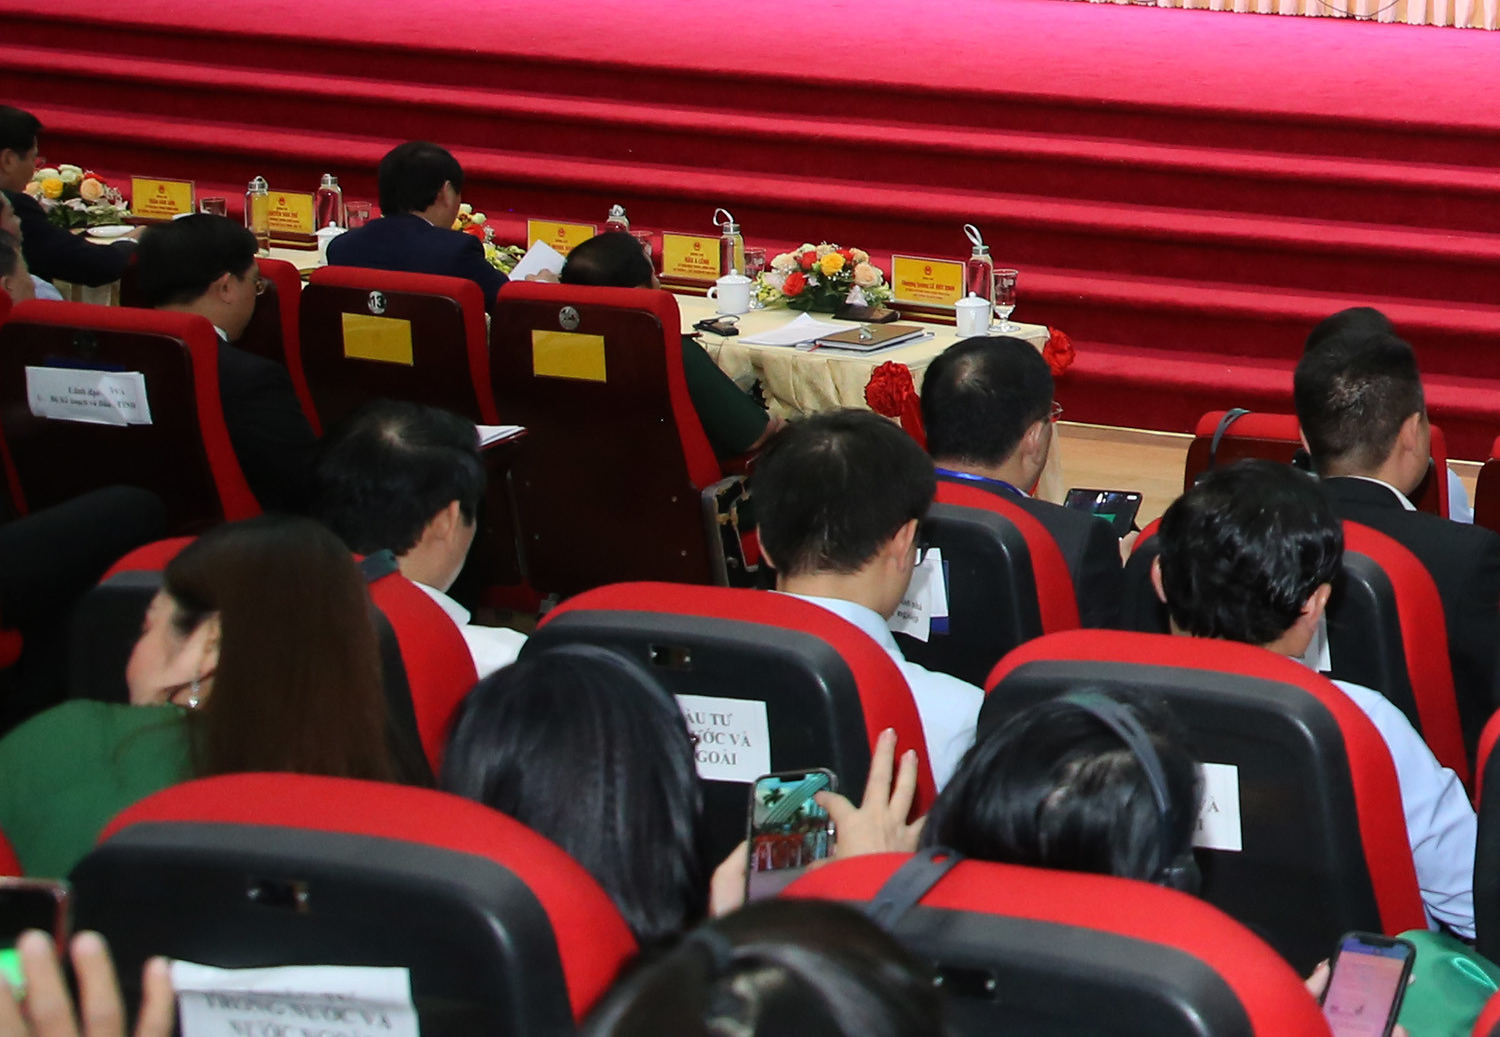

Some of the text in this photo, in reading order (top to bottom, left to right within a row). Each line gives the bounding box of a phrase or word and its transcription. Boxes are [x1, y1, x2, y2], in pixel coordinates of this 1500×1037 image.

[710, 712, 732, 726] TƯ
[729, 730, 752, 747] VÀ
[696, 748, 736, 765] GOÀI
